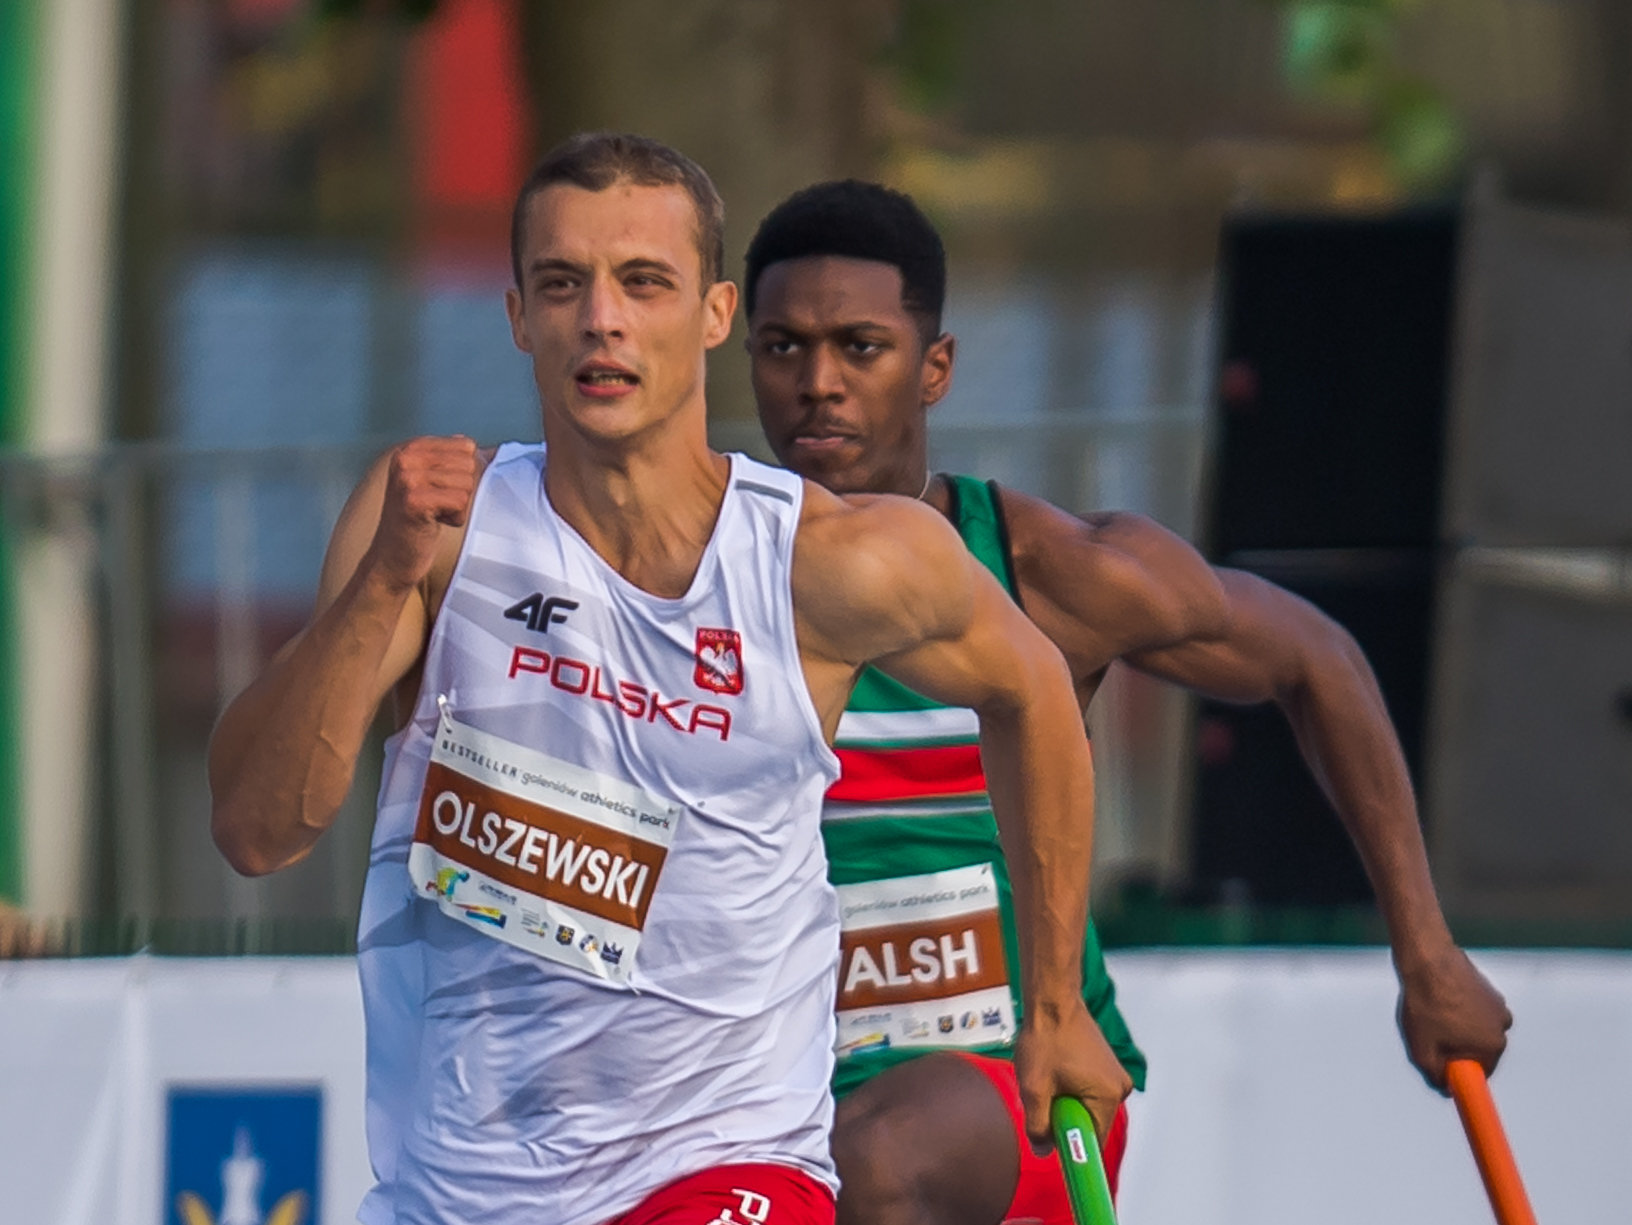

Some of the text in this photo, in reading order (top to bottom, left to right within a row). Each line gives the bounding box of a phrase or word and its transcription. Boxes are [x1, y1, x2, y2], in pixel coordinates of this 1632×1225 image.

[503, 592, 580, 634] 4F
[508, 645, 733, 741] POLSKA
[441, 739, 517, 778] BESTSELLER
[580, 790, 637, 818] athletics
[639, 811, 671, 830] park
[432, 790, 649, 909] OLSZEWSKI
[840, 929, 979, 992] ALSH
